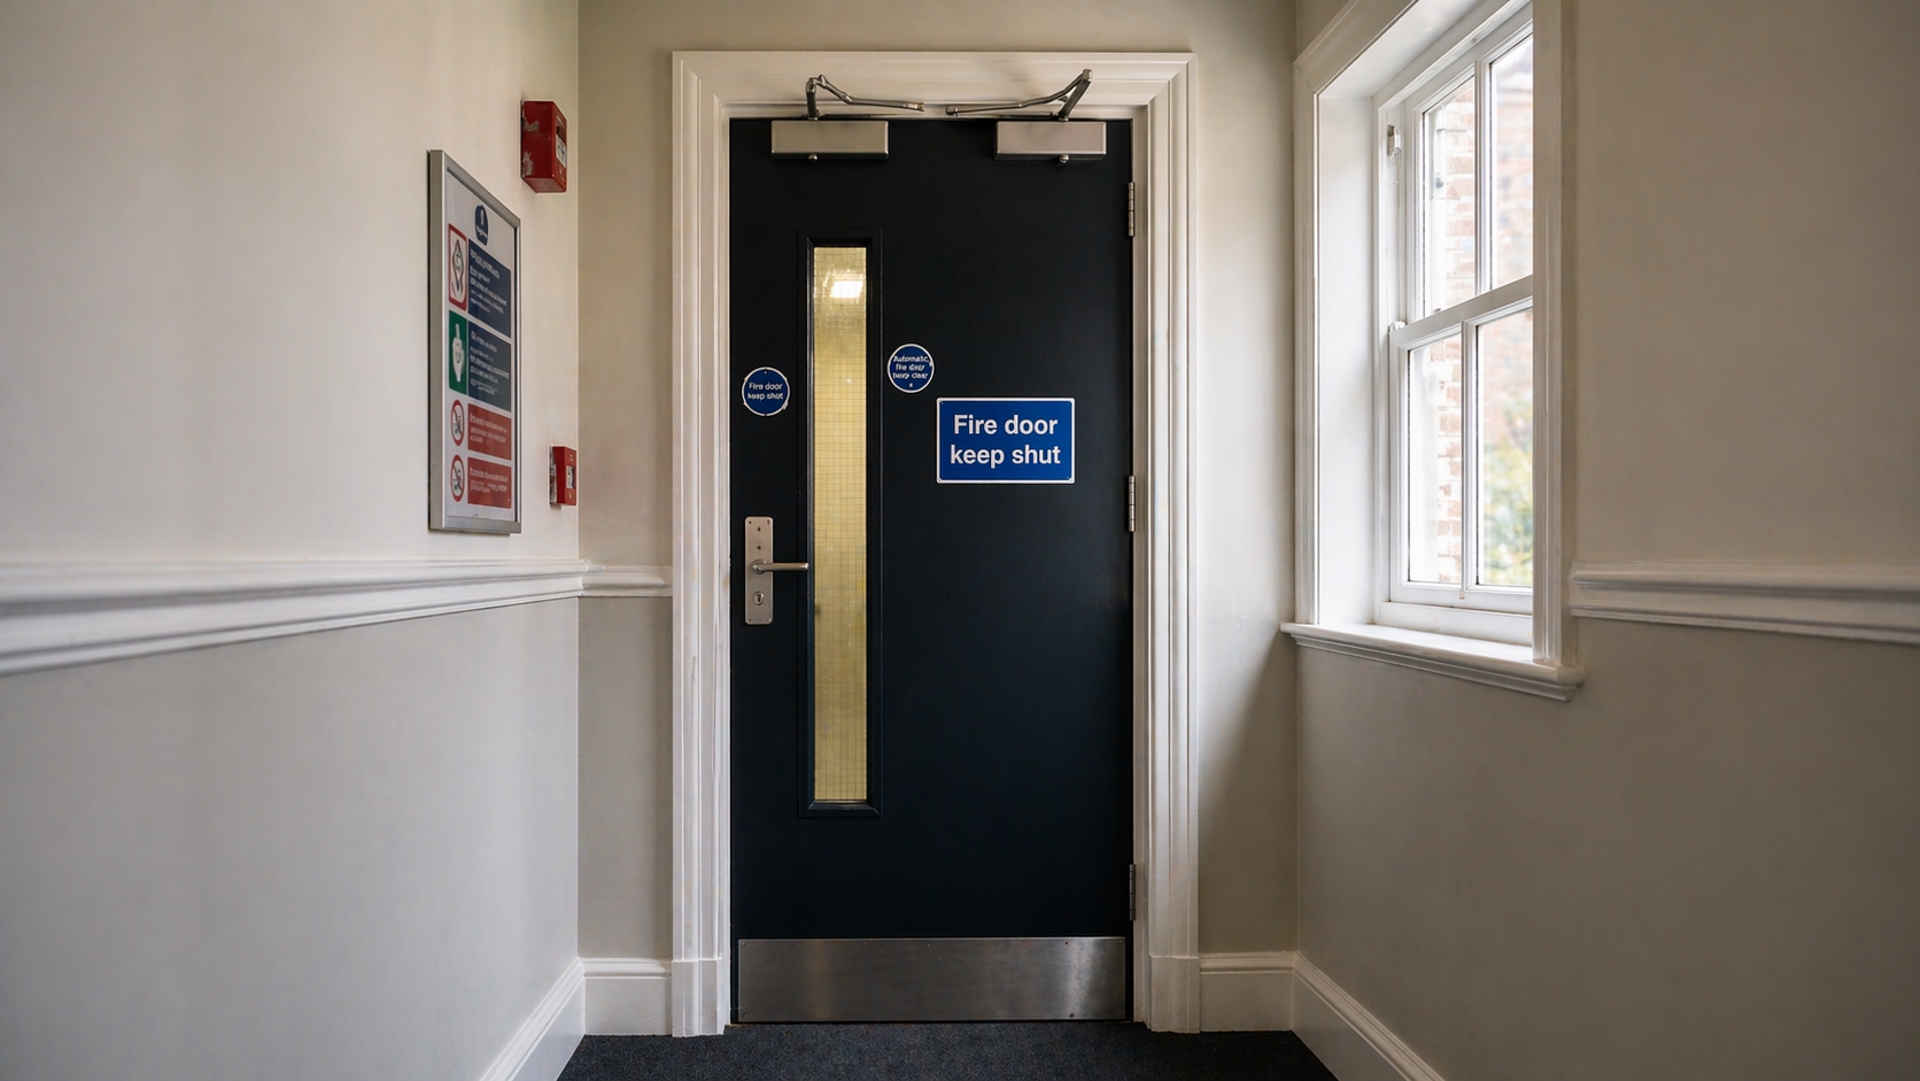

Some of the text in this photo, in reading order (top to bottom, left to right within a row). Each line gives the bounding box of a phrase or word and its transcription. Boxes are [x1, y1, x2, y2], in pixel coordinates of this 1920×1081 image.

[765, 382, 783, 390] door
[954, 414, 1058, 435] Fire door
[950, 444, 1061, 469] keep shut
